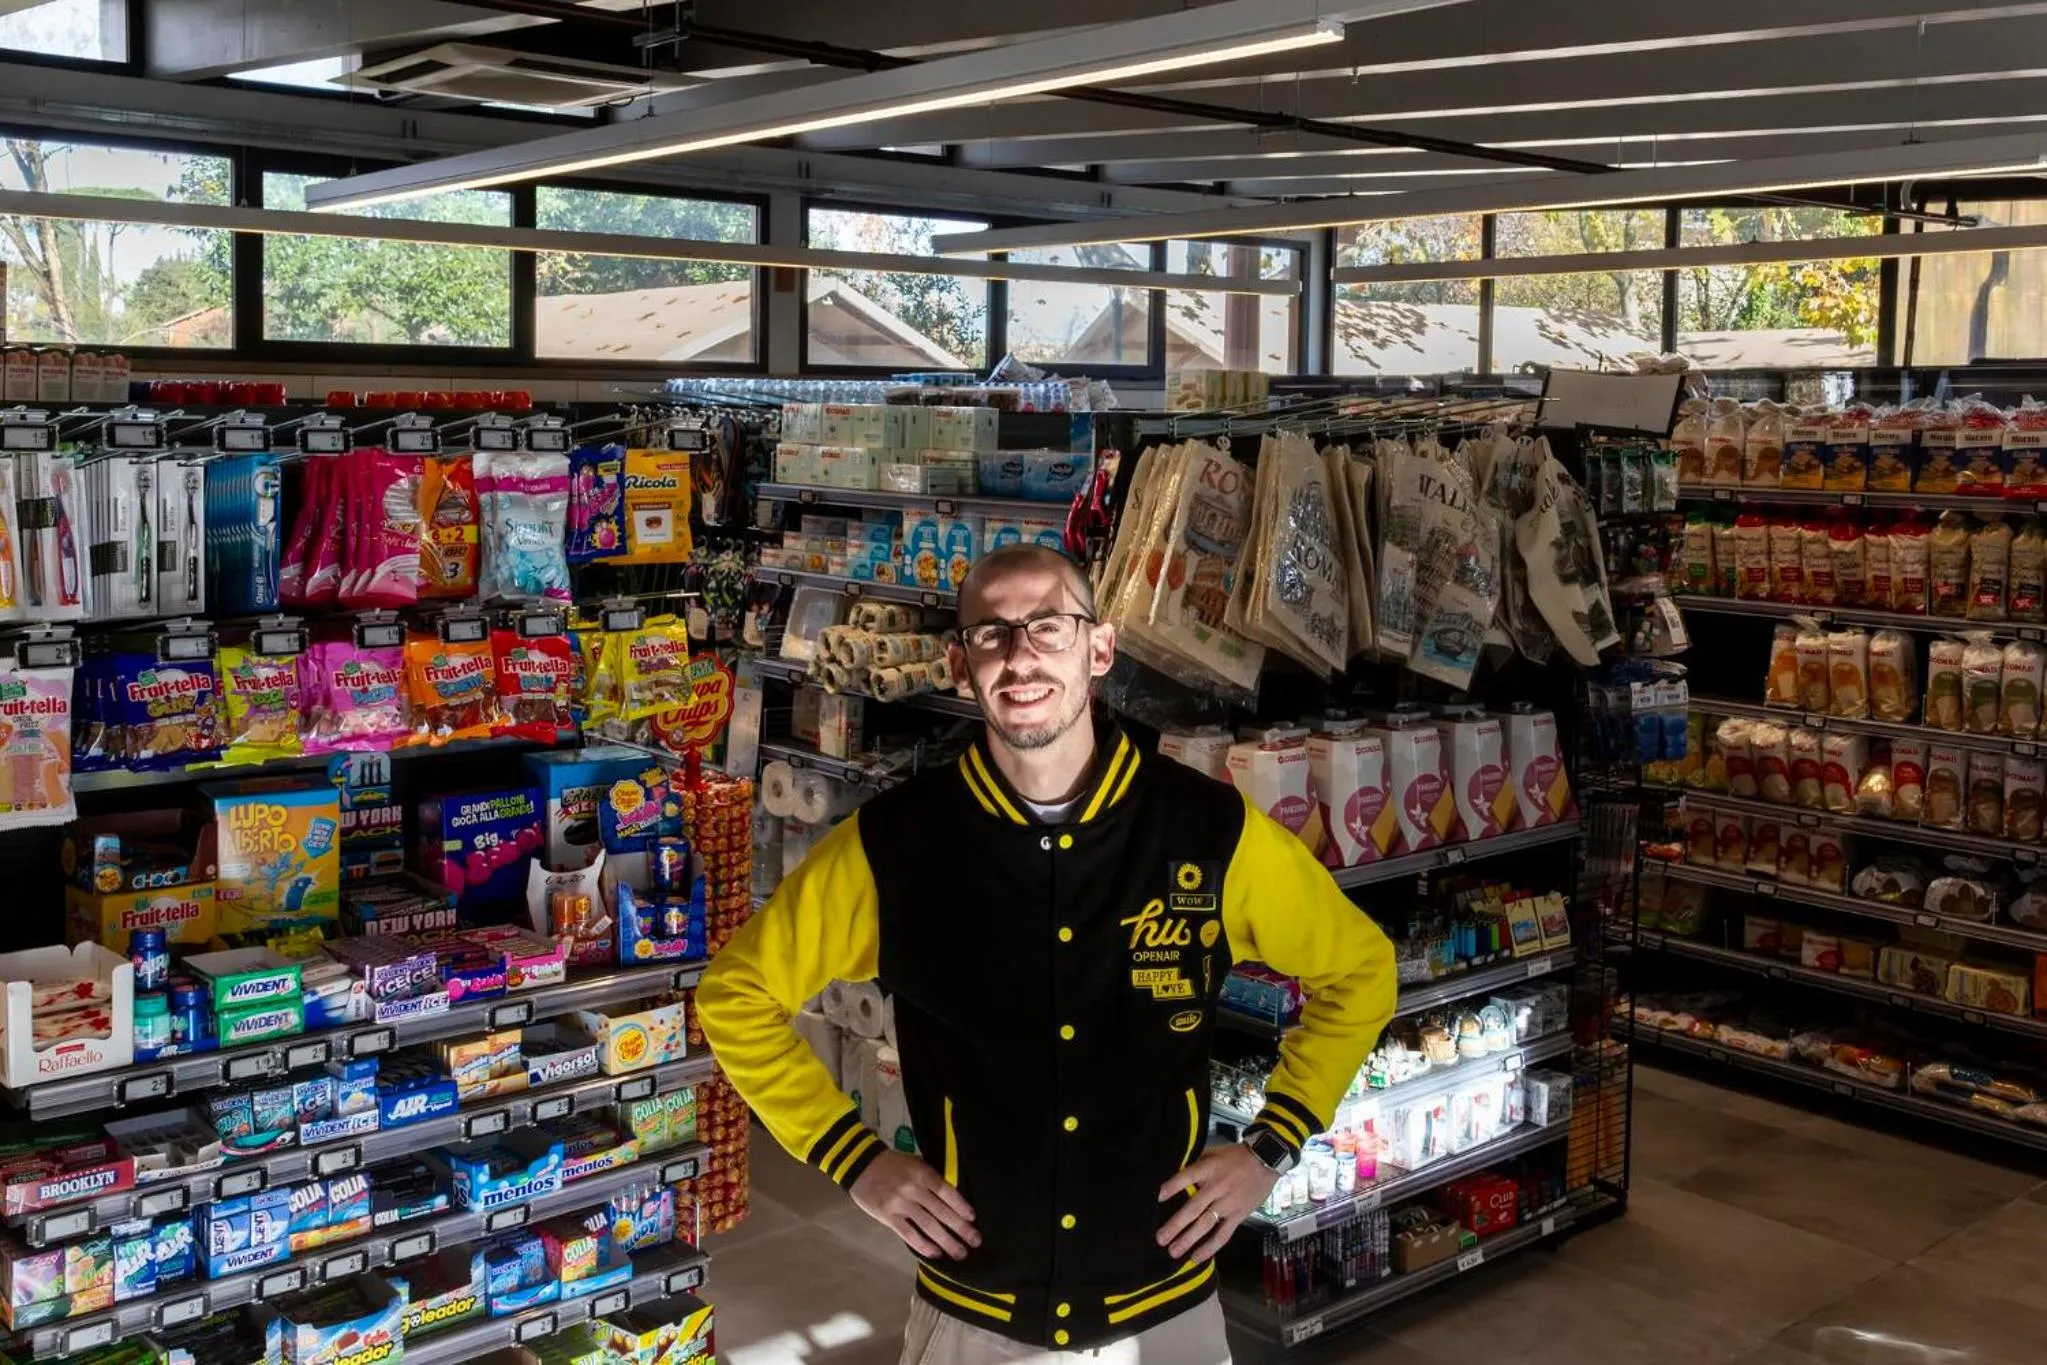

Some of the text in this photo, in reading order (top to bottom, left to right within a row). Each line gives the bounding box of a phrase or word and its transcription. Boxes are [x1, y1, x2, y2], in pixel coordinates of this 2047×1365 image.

[625, 475, 677, 488] Ricola
[432, 530, 439, 541] 6
[454, 527, 464, 541] 2
[446, 562, 459, 579] 3
[422, 654, 493, 684] Fruit-tella
[502, 656, 568, 676] Fruit-tella
[128, 672, 212, 701] Fruit-tella
[234, 669, 294, 690] Fruit-tella
[334, 667, 402, 690] Fruit-tell
[230, 802, 287, 831] LUPO
[358, 804, 403, 826] YORK
[451, 814, 478, 827] GIOCA
[479, 811, 500, 824] ALLA
[473, 831, 499, 850] Big
[1177, 896, 1202, 906] WOW
[122, 903, 200, 929] Fruit-tella
[411, 907, 457, 931] YORK
[1133, 951, 1180, 962] OPENAIR
[230, 977, 287, 996] VIVIDENT
[1137, 970, 1173, 982] HAPPY
[380, 994, 449, 1017] VIVIDENT ICE
[233, 1011, 290, 1033] VIVIDENT
[38, 1051, 103, 1074] Raffaello
[539, 1047, 596, 1083] Vigorsol
[388, 1094, 428, 1120] AIR
[303, 1113, 377, 1137] VIVIDENT ICE
[562, 1155, 614, 1179] mentos
[40, 1170, 115, 1200] BROOKLYN
[483, 1175, 555, 1207] mentos
[227, 1248, 275, 1268] VIVIDENT
